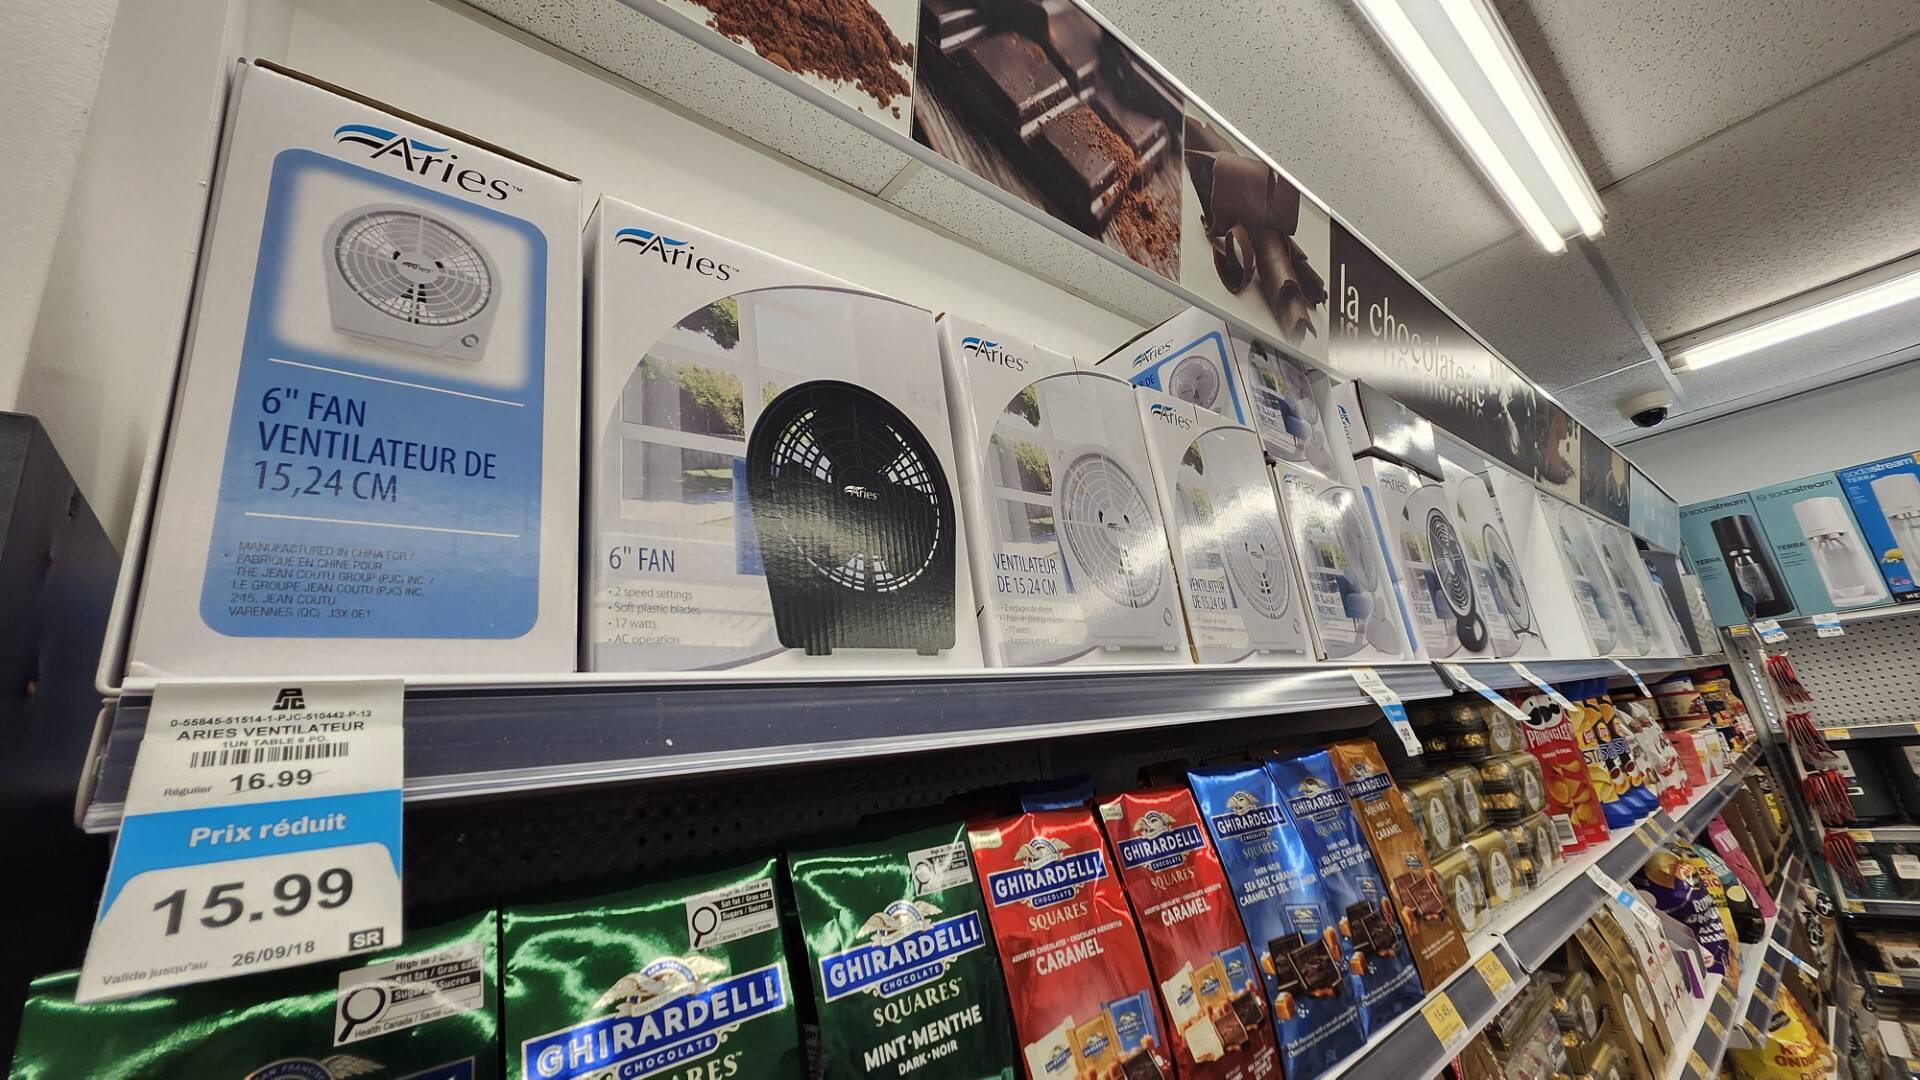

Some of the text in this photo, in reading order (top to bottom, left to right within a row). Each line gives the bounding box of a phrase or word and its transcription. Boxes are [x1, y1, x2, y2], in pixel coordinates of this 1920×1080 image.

[366, 134, 511, 202] Aries
[638, 232, 732, 282] Aries
[1340, 263, 1360, 323] la
[1369, 296, 1486, 408] chocolaterie
[973, 338, 1025, 372] Aries
[1139, 342, 1171, 368] Aries
[261, 387, 367, 427] 6" FAN
[1159, 404, 1192, 431] Aries
[258, 421, 497, 480] VENTILATEUR DE
[1843, 457, 1914, 480] sodastream
[254, 459, 398, 503] 15,24 CM
[1768, 479, 1833, 501] sodastream
[849, 486, 878, 500] Aries
[1689, 498, 1747, 517] sodastream
[239, 541, 335, 557] MANUFACTURED
[337, 547, 348, 557] IN
[351, 548, 383, 560] CHINA
[386, 550, 408, 561] FOR
[1776, 541, 1806, 552] TERRA
[236, 553, 382, 571] FABRIQUE EN CHINE POUR
[609, 545, 675, 573] 6" FAN
[992, 552, 1058, 576] VENTILATEUR
[1695, 556, 1722, 566] TERRA
[236, 566, 257, 578] THE
[261, 567, 293, 579] JEAN
[296, 569, 335, 581] COUTU
[338, 571, 375, 583] GROUP
[378, 573, 405, 585] (PJC)
[996, 575, 1058, 596] DE 15,24 CM
[1188, 577, 1226, 595] VENTILATEUR
[232, 579, 402, 597] LE GROUPE JEAN COUTU (PJC)
[262, 593, 293, 605] JEAN
[296, 594, 336, 606] COUTU
[614, 587, 693, 601] 2 speed settings
[228, 606, 293, 617] VARENNES
[296, 607, 320, 619] (QC)
[327, 608, 348, 619] J3X
[614, 602, 701, 617] Soft plastic blades
[1192, 594, 1229, 612] DE 15,24 CM
[614, 618, 657, 630] 17 watts
[614, 634, 680, 649] AC operation
[176, 721, 365, 741] ARIES VENTILATEUR
[222, 734, 329, 749] 1UN TABLE 6 PO.
[163, 767, 313, 798] Régulier 16.99
[1291, 790, 1346, 815] GHIRARDELLI
[189, 811, 348, 848] Prix réduit
[1216, 808, 1285, 835] GHIRARDELLI
[1375, 823, 1402, 841] CARAMEL
[1123, 829, 1201, 862] GHIRARDELLI
[1151, 856, 1183, 870] CHOCOLATE
[995, 855, 1104, 898] GHIRARDELLI
[1150, 866, 1195, 892] SQUARES
[1244, 876, 1271, 893] SEA SALT
[152, 867, 354, 938] 15.99
[1033, 889, 1073, 906] CHOCOLATE
[1240, 882, 1290, 908] CARAMEL ET SEL
[722, 909, 744, 921] Sugars
[748, 902, 768, 913] Sucres
[1028, 901, 1089, 932] SQUARES
[1161, 896, 1212, 927] CARAMEL
[351, 930, 383, 950] SR
[102, 940, 316, 986] Valide jusqu'au 26/09/18
[395, 959, 418, 971] High
[829, 923, 979, 988] GHIRARDELLI
[1036, 937, 1105, 976] CARAMEL
[414, 970, 428, 981] fat
[437, 963, 459, 975] Gras
[437, 975, 471, 990] Sucres
[882, 965, 941, 994] CHOCOLATE
[873, 981, 961, 1028] SQUARES
[354, 1023, 381, 1039] Health
[383, 1016, 413, 1031] Canada
[536, 976, 779, 1078] GHIRARDELLI
[623, 1036, 713, 1077] CHOCOLATE
